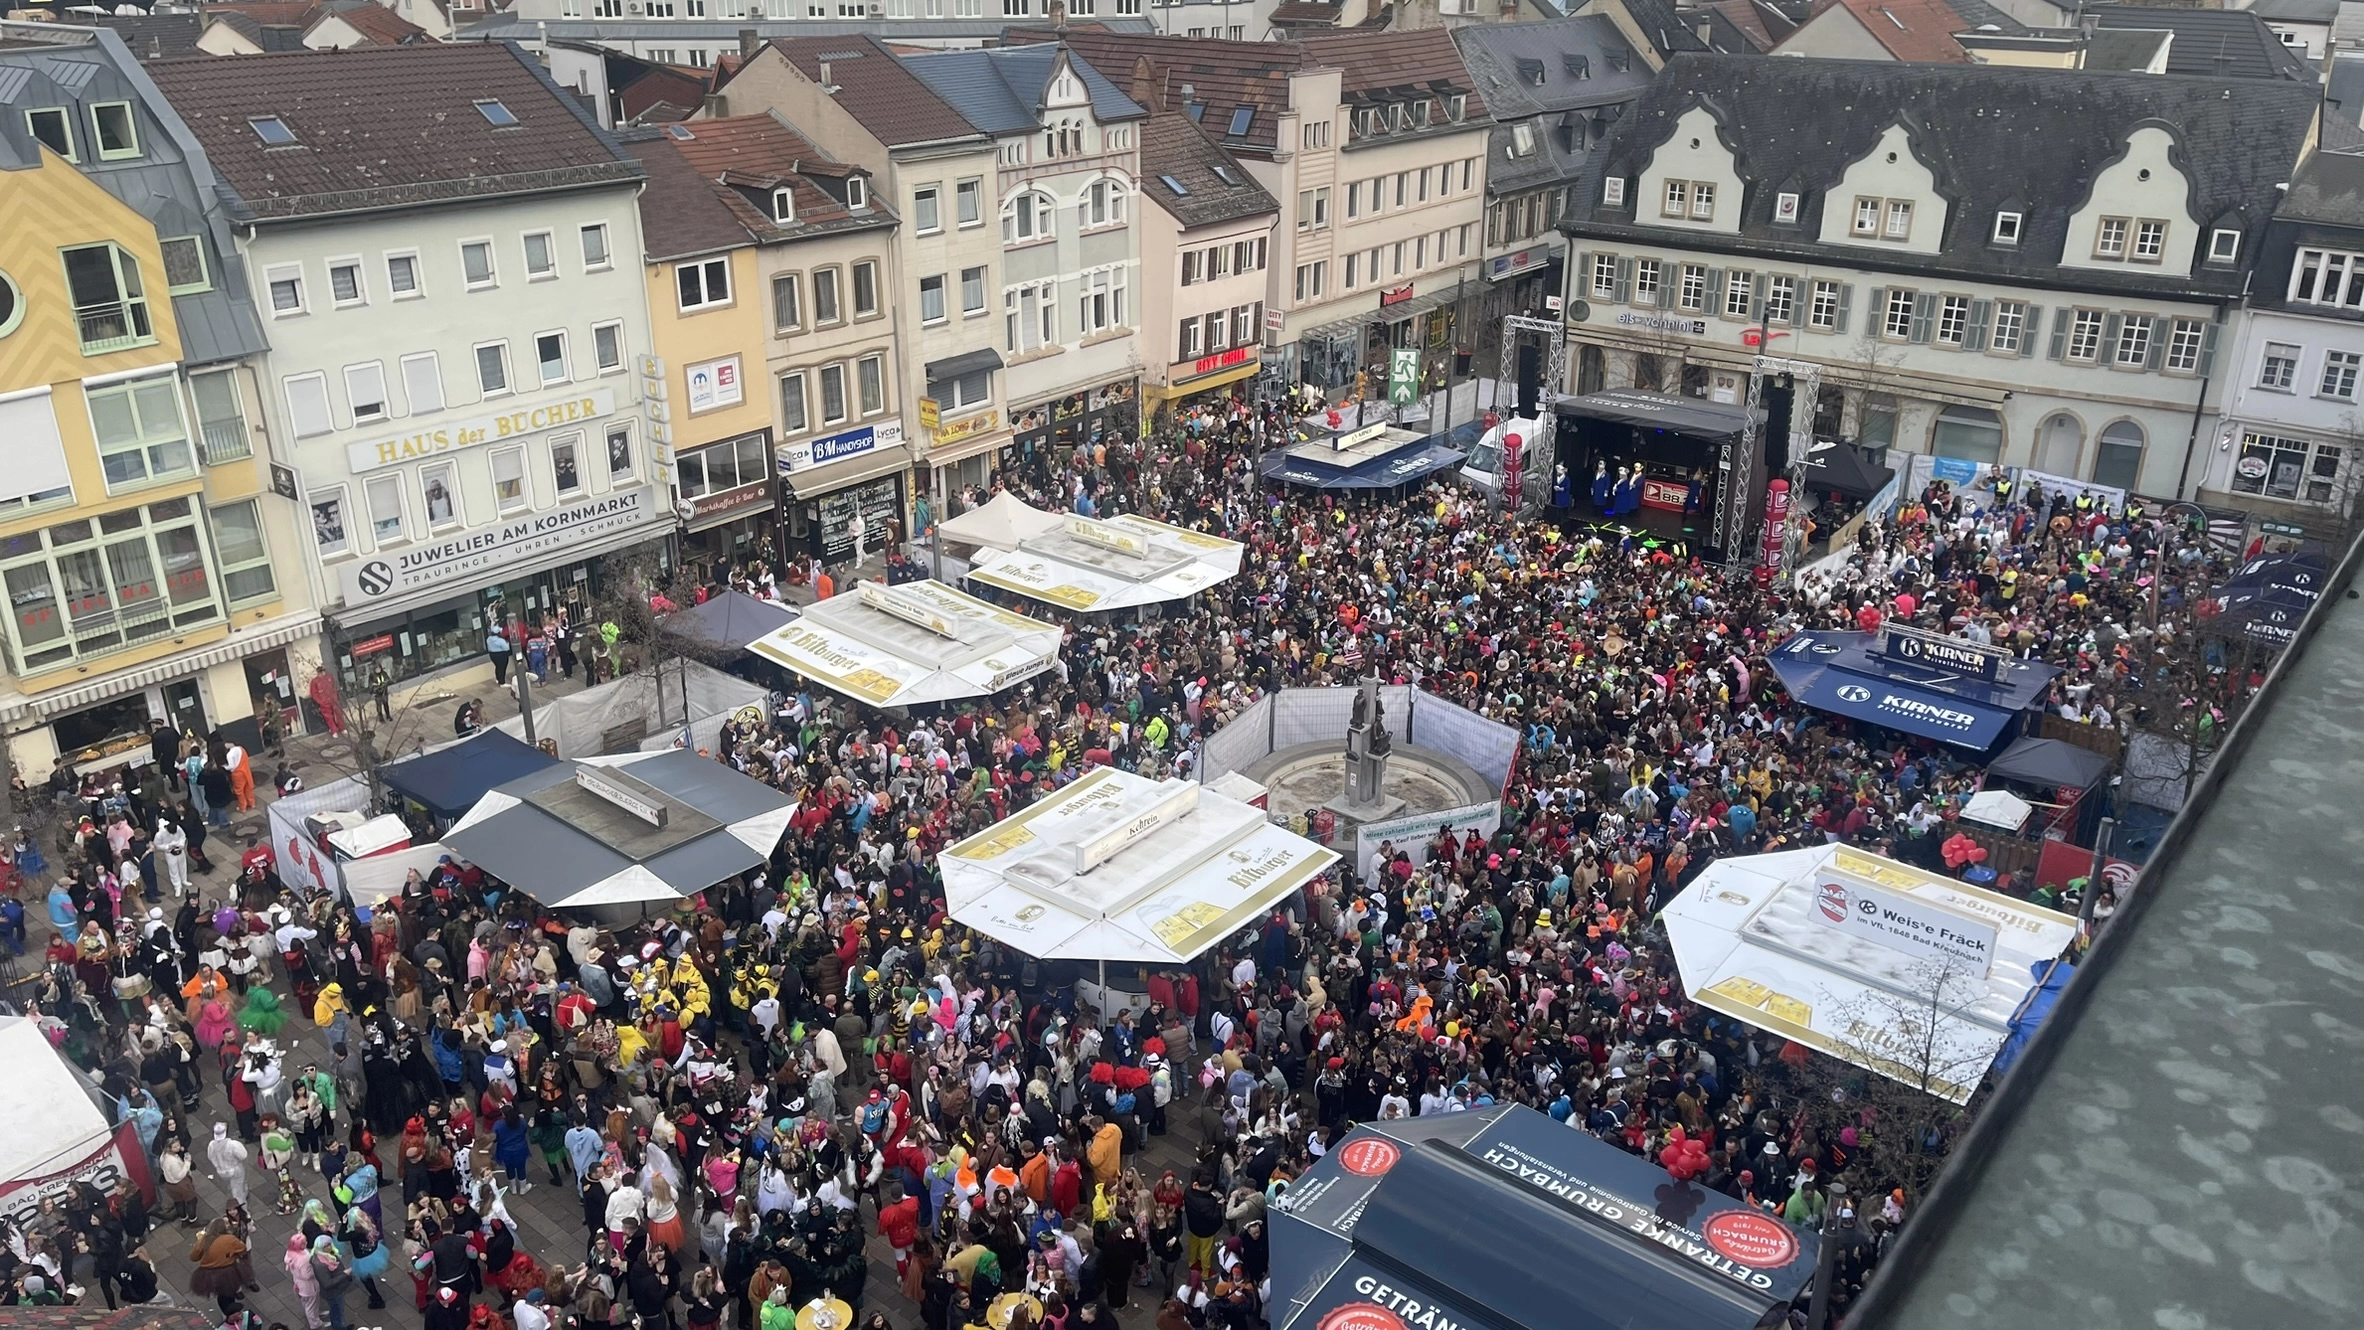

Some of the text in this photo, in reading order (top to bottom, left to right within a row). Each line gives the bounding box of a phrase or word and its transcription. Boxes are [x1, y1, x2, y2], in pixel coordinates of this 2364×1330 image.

[1267, 319, 1282, 329] GRILL
[1268, 311, 1281, 320] CITY
[1196, 347, 1247, 373] CITY GRILL
[376, 396, 597, 464] HAUS der BÜCHER
[646, 359, 669, 482] BÜCHER
[877, 427, 896, 439] Lyca
[951, 423, 969, 434] LONG
[814, 436, 873, 459] BM HANDYSHOP
[1392, 457, 1432, 475] KIRNER
[696, 498, 734, 515] Marktkaffee
[742, 492, 754, 501] Bar
[400, 493, 639, 570] JUWELIER AM KORNMARKT
[403, 513, 641, 585] TRAURINGE UHREN SCHMUCK
[997, 565, 1044, 585] Bitburger
[791, 633, 860, 670] Bitburger
[1928, 643, 1985, 667] KIRNER
[1006, 668, 1024, 680] Blaue
[1025, 660, 1044, 671] Jungs
[1878, 704, 1969, 731] Privatbrauerei
[1883, 694, 1975, 726] KIRNER
[1059, 782, 1123, 818] Bitburger
[1227, 848, 1294, 890] Bitburger
[1857, 916, 1983, 963] im VfL 1848 Bad Kreuznach
[1940, 927, 1985, 951] Fräck
[39, 1147, 111, 1184] ANTENNE
[1483, 1148, 1624, 1221] GRUMBACH
[1498, 1141, 1702, 1242] Service für Gastronomie und Veranstaltungen
[7, 1193, 35, 1211] BAD
[1713, 1227, 1788, 1248] GRUMBACH
[1723, 1238, 1776, 1256] Getränke
